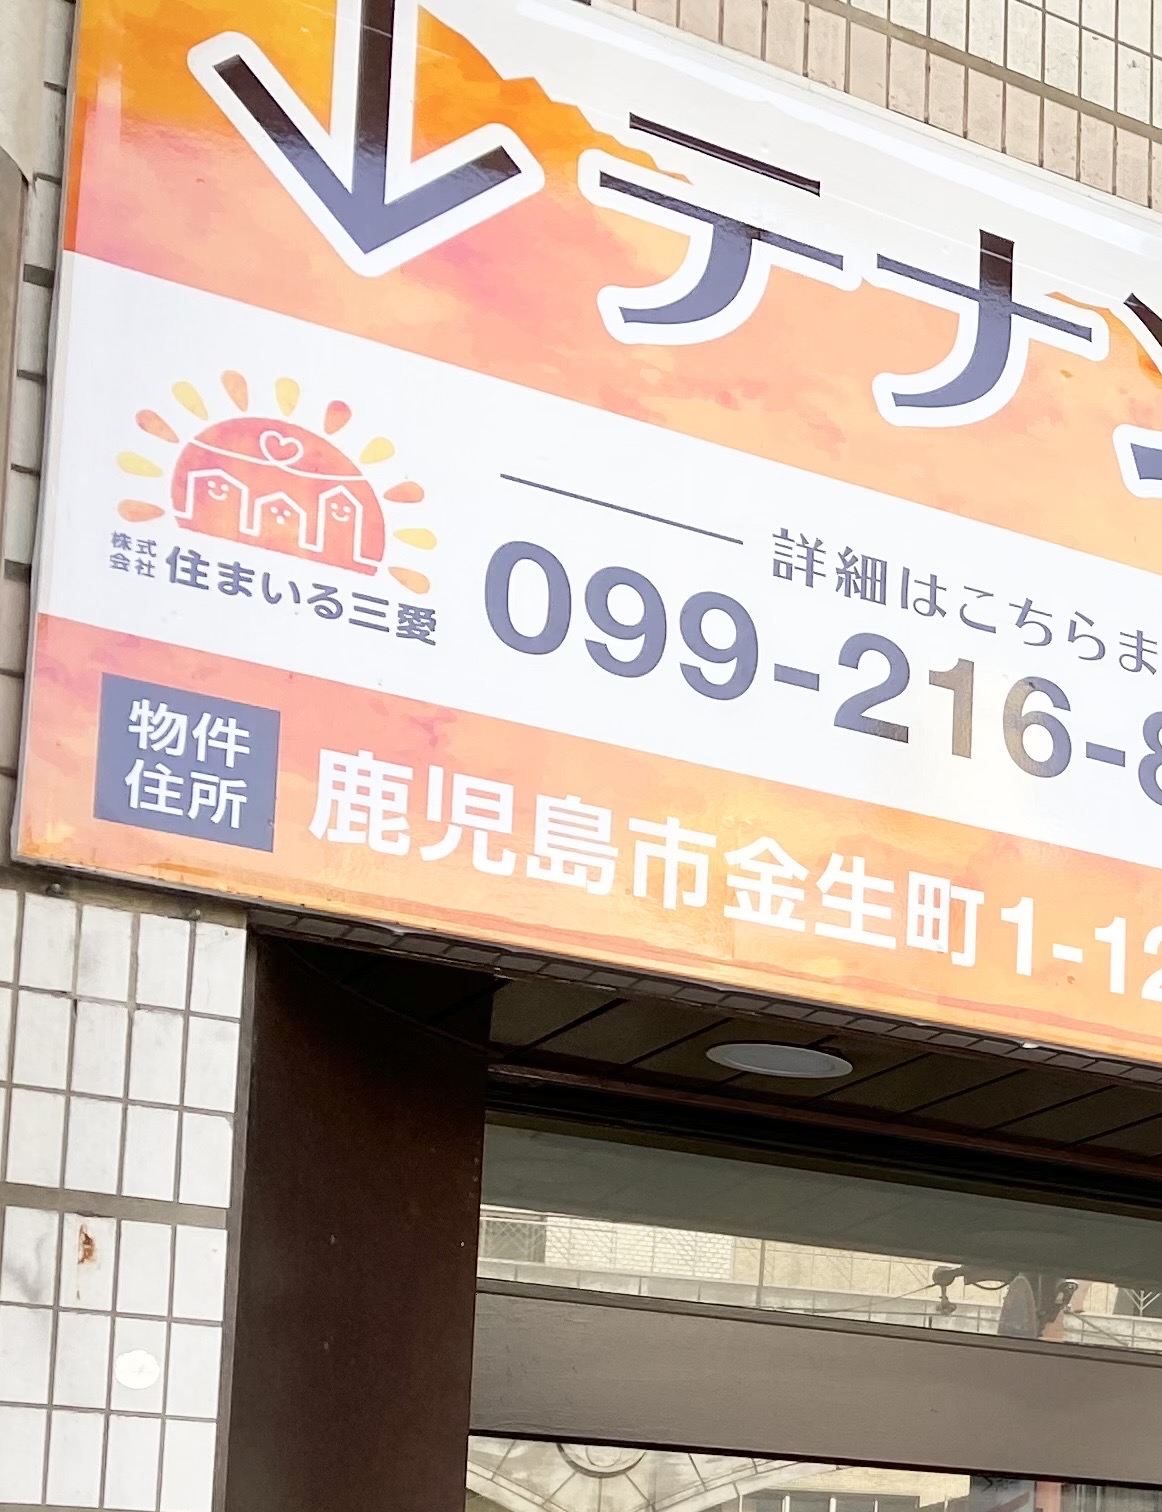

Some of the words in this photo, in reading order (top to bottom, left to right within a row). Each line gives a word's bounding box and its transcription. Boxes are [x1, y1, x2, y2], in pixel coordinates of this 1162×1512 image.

[109, 552, 156, 579] 会社
[110, 531, 157, 558] 株式
[165, 545, 437, 647] 住まいる三愛
[127, 698, 252, 769] 物件
[123, 759, 248, 830] 住所
